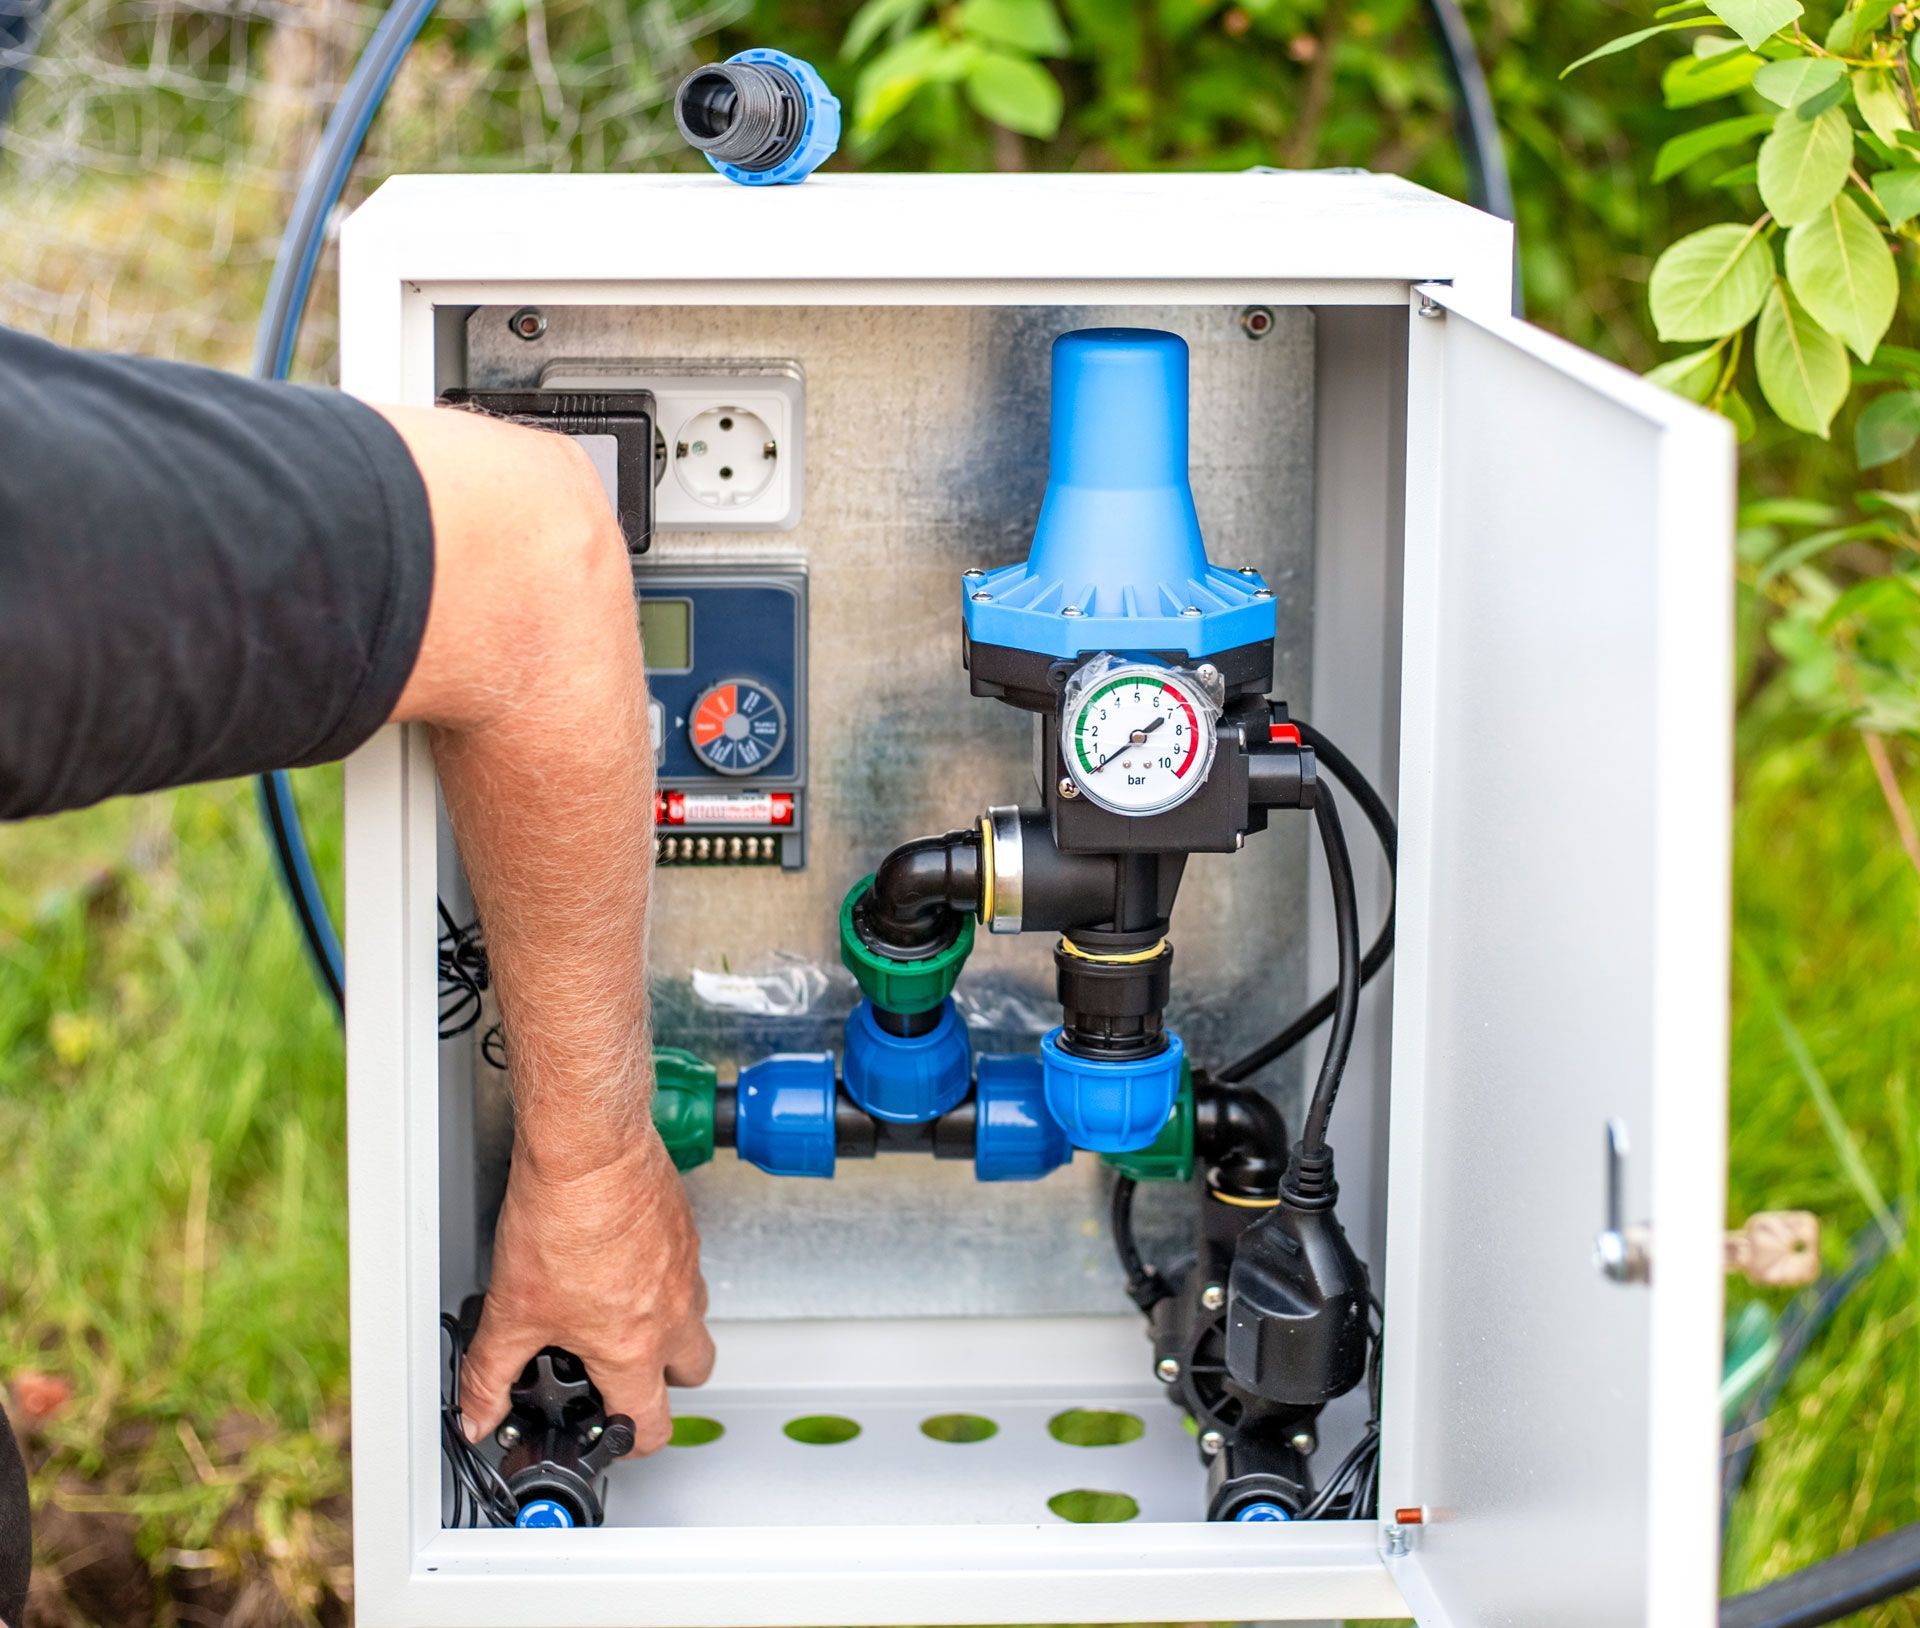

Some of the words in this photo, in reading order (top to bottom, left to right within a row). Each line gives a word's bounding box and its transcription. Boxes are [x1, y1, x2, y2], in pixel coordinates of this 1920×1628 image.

[1114, 697, 1121, 708] 4
[1134, 692, 1141, 704] 5
[1153, 696, 1160, 708] 6
[1100, 709, 1107, 721] 3
[1167, 708, 1174, 719] 7
[1091, 725, 1098, 737] 2
[1175, 724, 1183, 736] 8
[1093, 743, 1098, 753] 1
[1173, 743, 1181, 755] 9
[1099, 754, 1106, 765] 0
[1158, 757, 1172, 769] 10
[1127, 775, 1146, 786] bar
